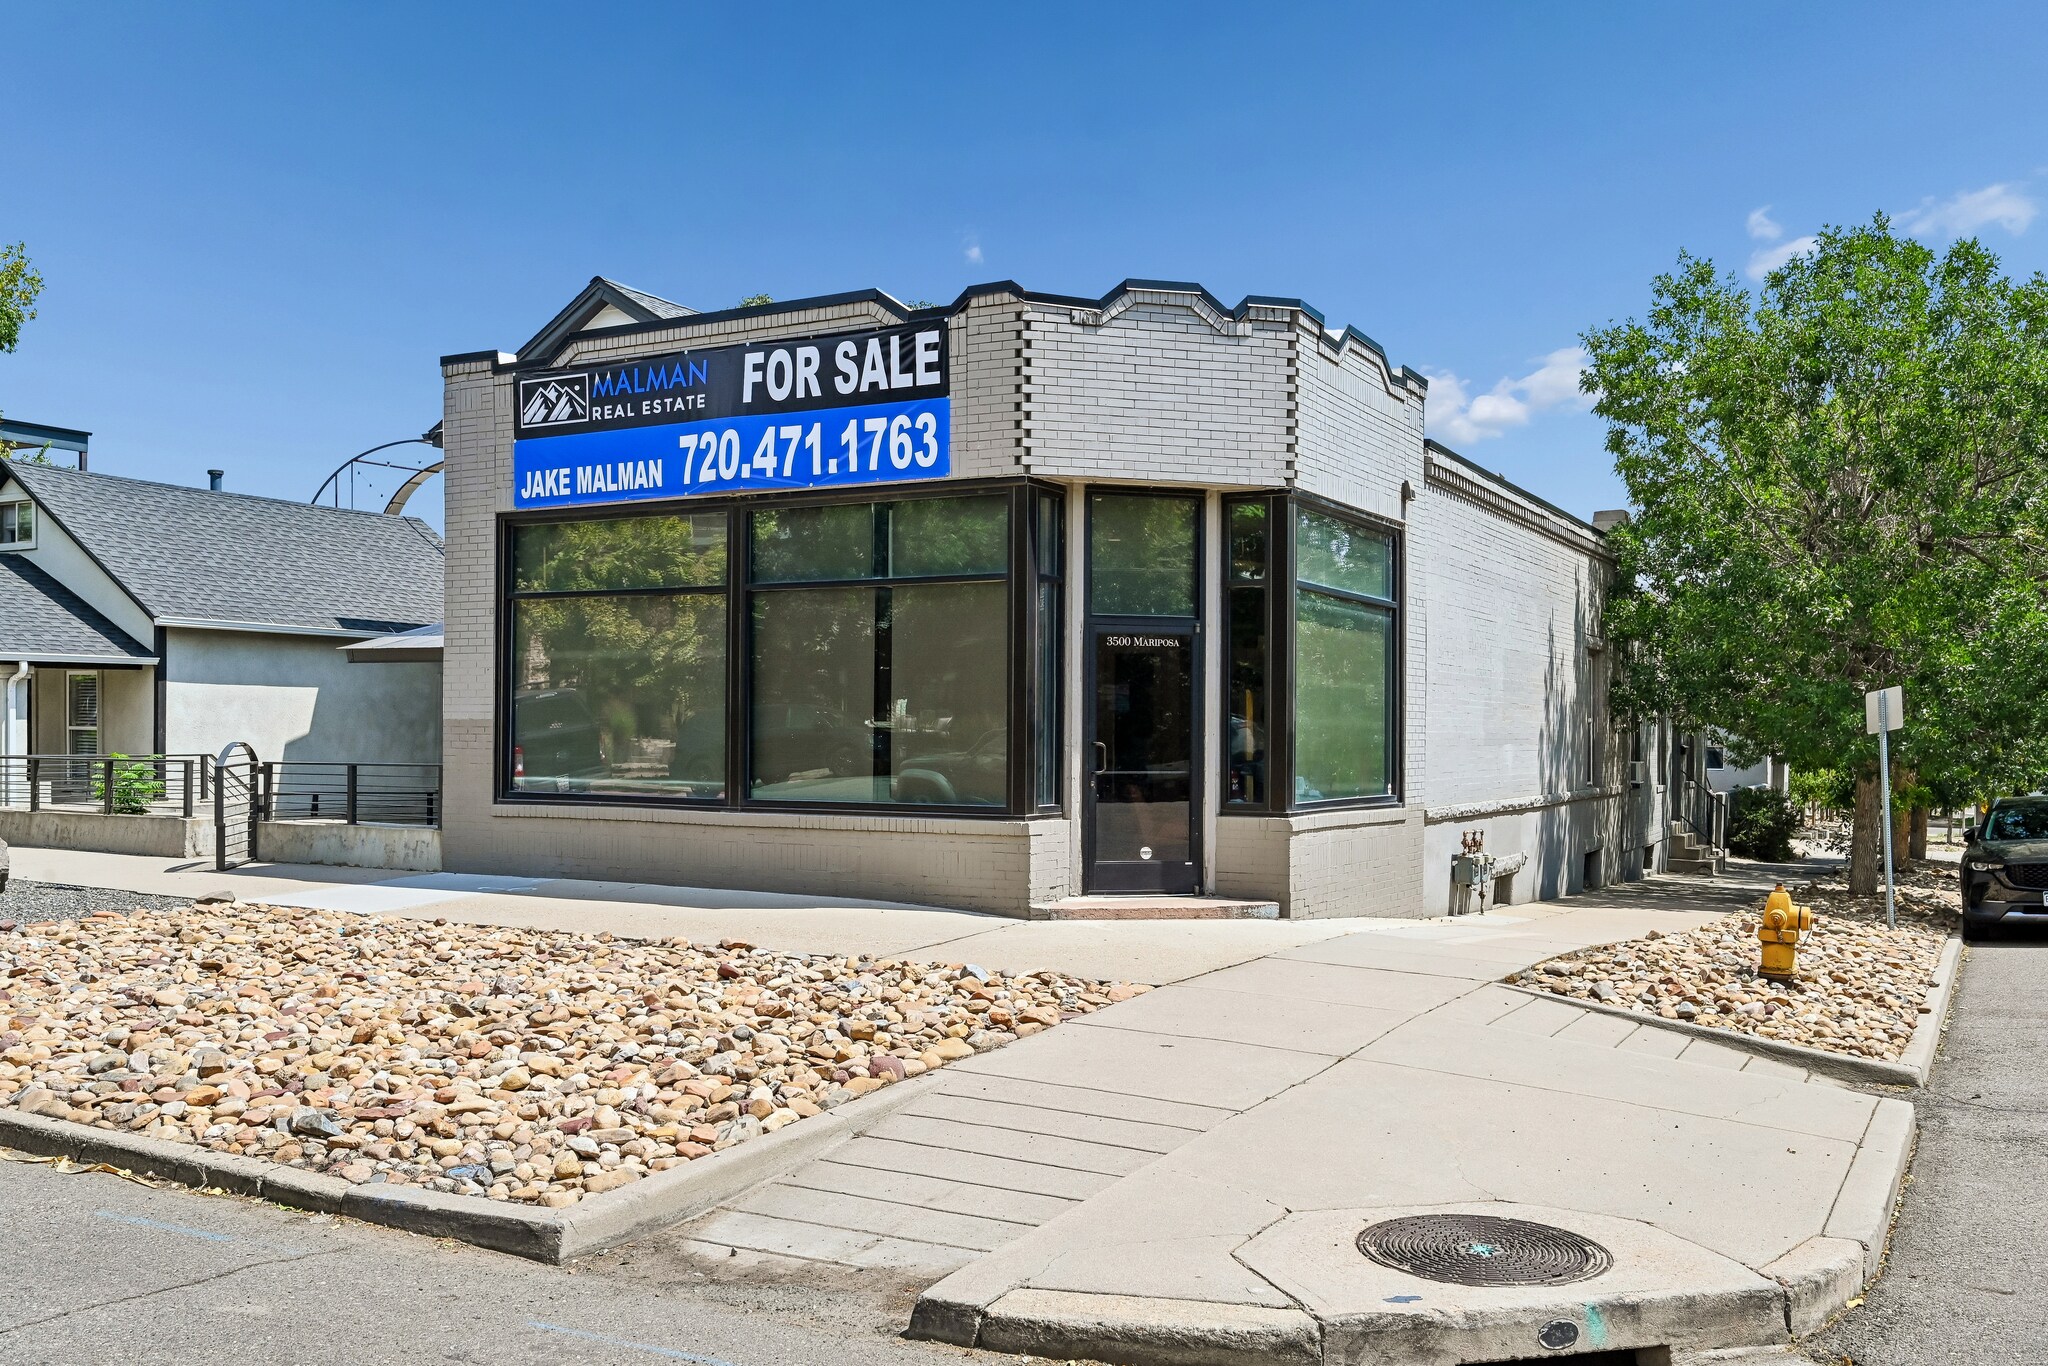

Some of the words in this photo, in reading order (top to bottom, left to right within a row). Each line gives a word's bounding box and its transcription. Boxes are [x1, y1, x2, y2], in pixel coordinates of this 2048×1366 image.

[592, 360, 708, 398] MALMAN
[742, 345, 821, 404] FOR
[833, 329, 941, 395] SALE
[592, 402, 635, 421] REAL
[642, 393, 706, 415] ESTATE
[678, 411, 939, 486] 720.471.1763
[520, 467, 571, 500] JAKE
[576, 458, 663, 495] MALMAN
[1106, 636, 1131, 646] 3500
